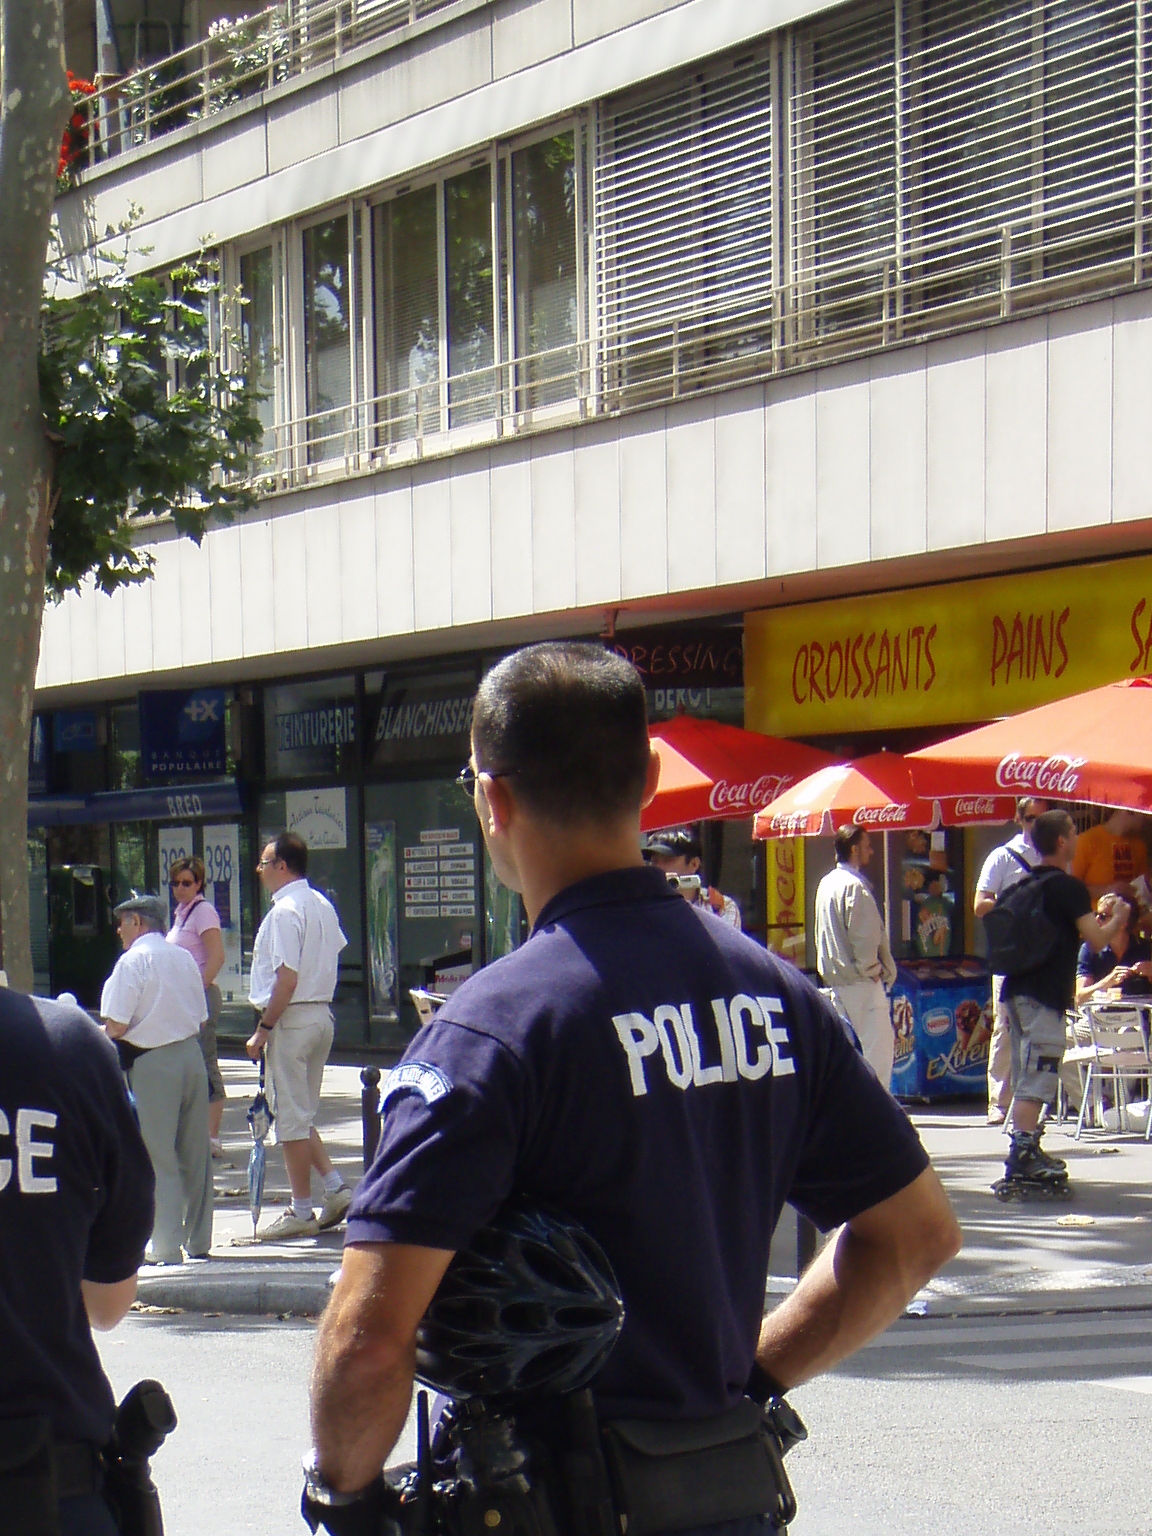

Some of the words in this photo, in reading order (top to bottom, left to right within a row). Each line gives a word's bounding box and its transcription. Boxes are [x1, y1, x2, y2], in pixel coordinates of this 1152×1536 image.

[792, 623, 937, 705] CROISSANTS
[991, 606, 1070, 687] PAINS
[277, 706, 355, 751] TEINTURERIE
[151, 760, 222, 772] POPULAIRE
[166, 794, 203, 817] BRED
[205, 844, 233, 885] 398
[611, 993, 796, 1097] POLICE
